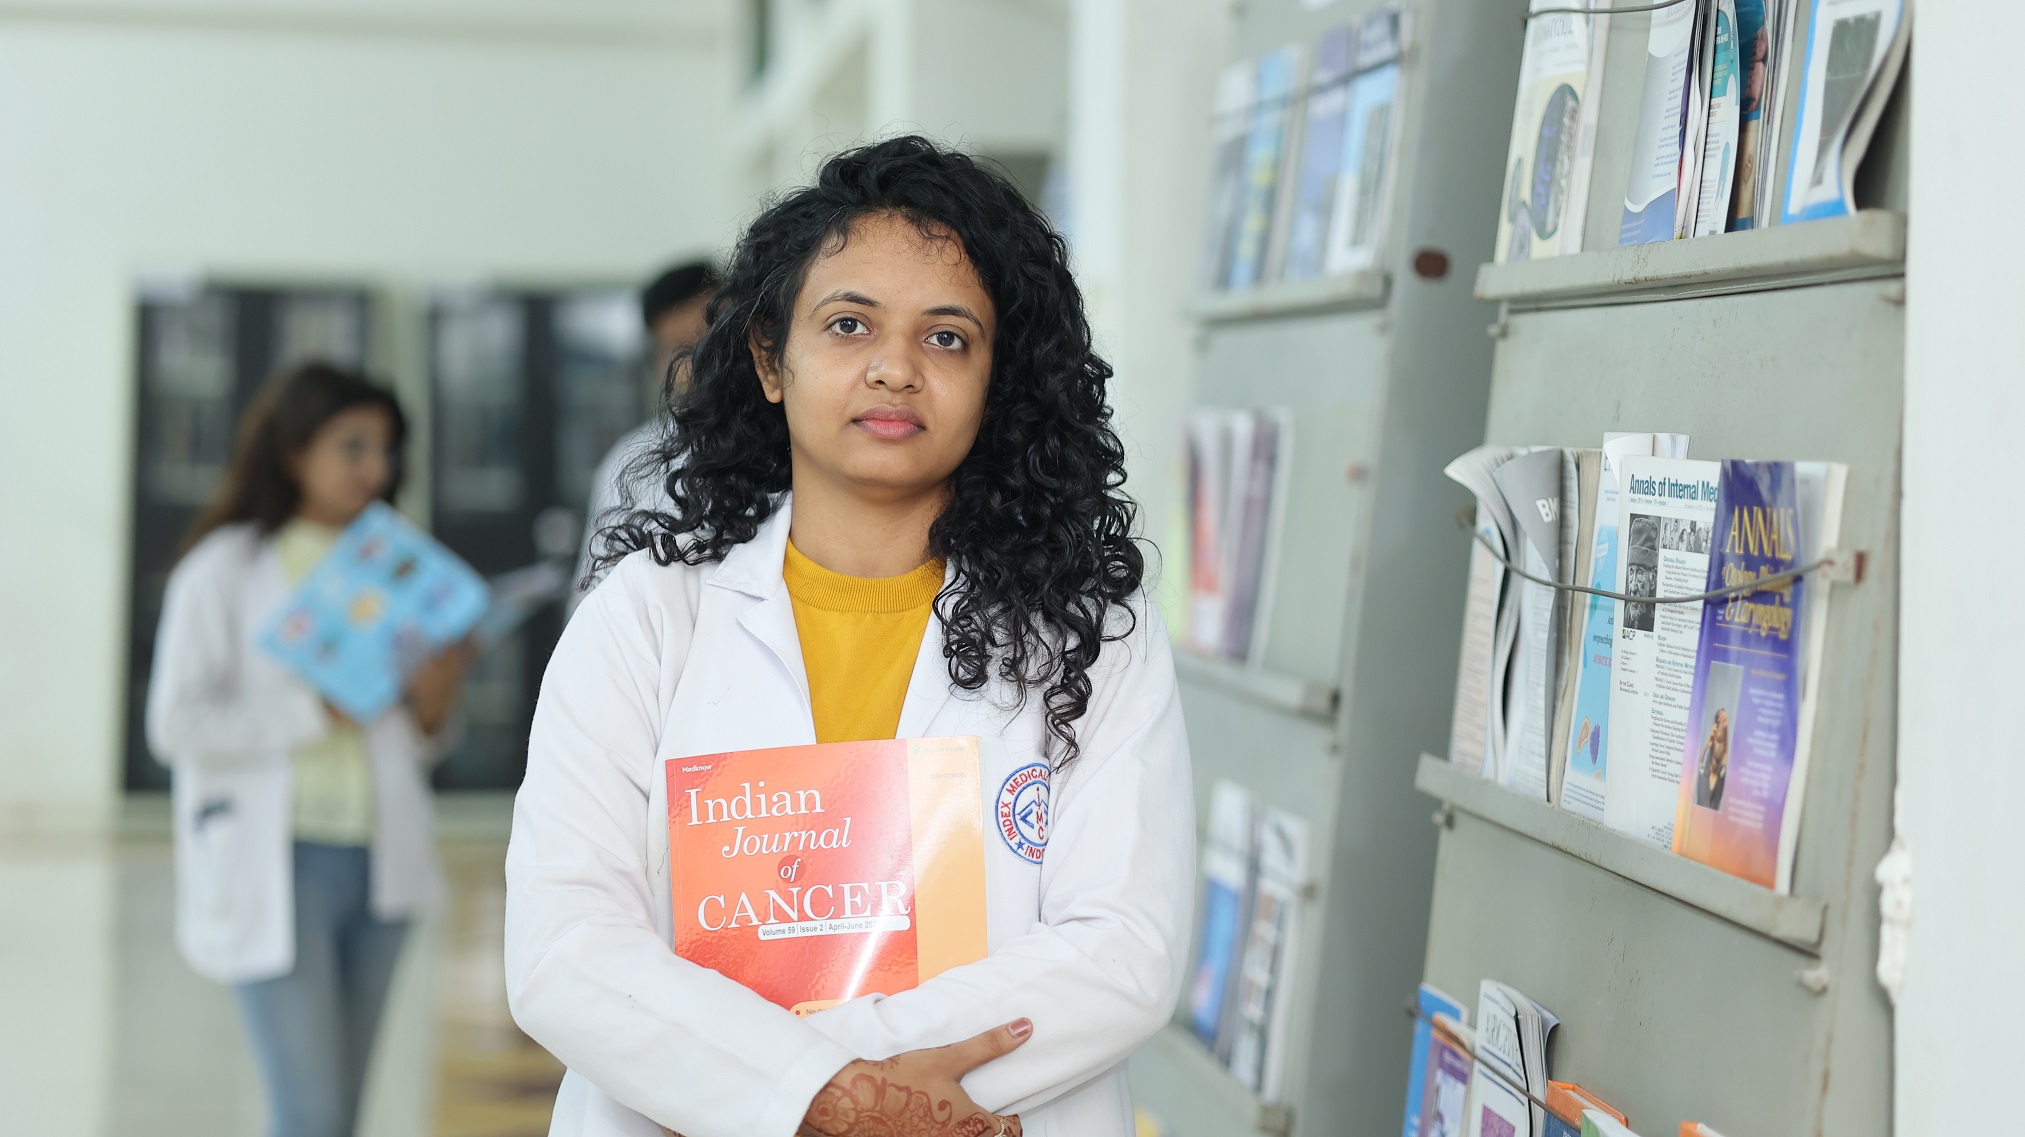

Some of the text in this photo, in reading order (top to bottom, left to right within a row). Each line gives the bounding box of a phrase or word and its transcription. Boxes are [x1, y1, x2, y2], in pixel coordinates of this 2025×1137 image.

[1629, 473, 1656, 497] Annals
[1658, 477, 1667, 497] of
[1667, 477, 1699, 501] Internal
[1725, 505, 1795, 561] ANNALS
[681, 764, 712, 773] Medknow
[685, 781, 825, 826] Indian
[1001, 768, 1048, 841] INDEX MEDICAL
[721, 816, 852, 859] Journal
[780, 858, 801, 882] of
[697, 880, 912, 931] CANCER
[761, 928, 787, 937] Volume
[787, 926, 796, 934] 59
[800, 925, 818, 933] Issue
[819, 923, 824, 932] 2
[828, 921, 864, 931] April-June
